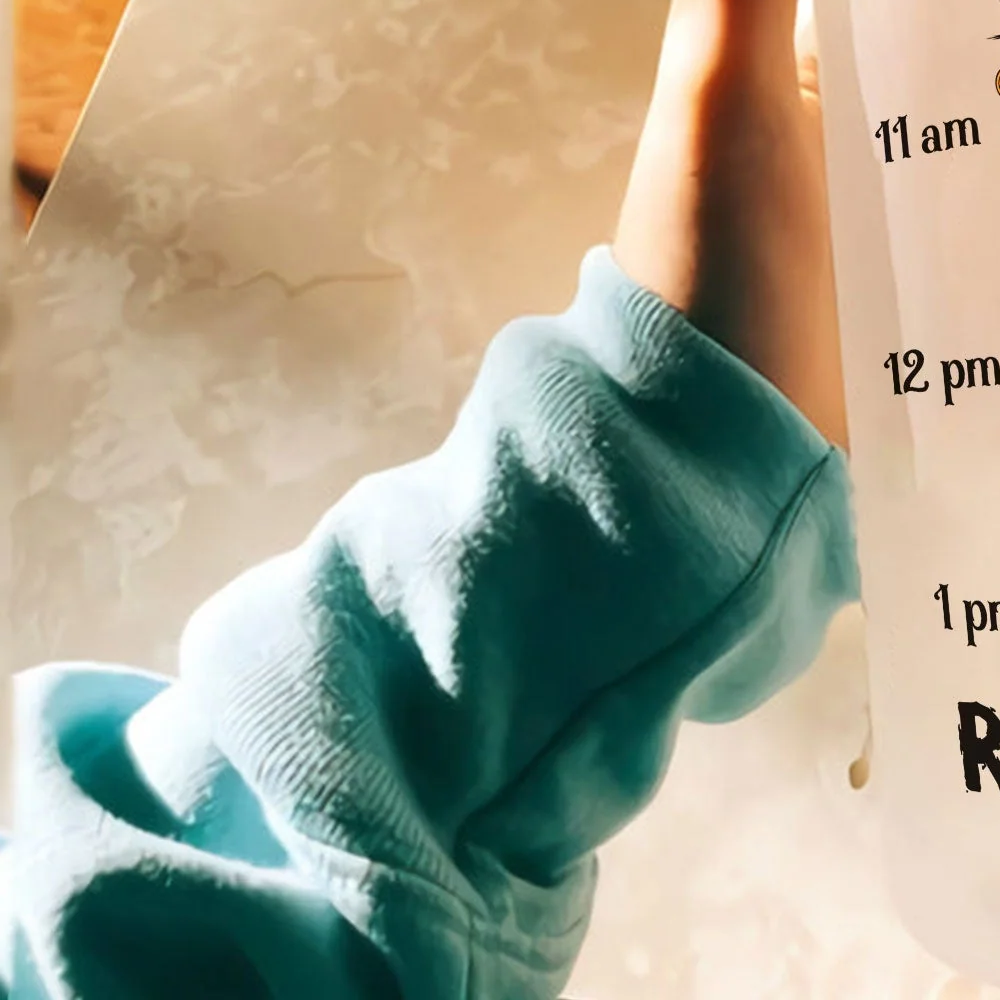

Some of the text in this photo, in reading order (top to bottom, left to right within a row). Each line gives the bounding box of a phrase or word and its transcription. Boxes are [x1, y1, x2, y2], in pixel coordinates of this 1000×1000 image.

[874, 114, 982, 164] 11 am
[883, 348, 930, 396] 12
[933, 583, 954, 631] 1
